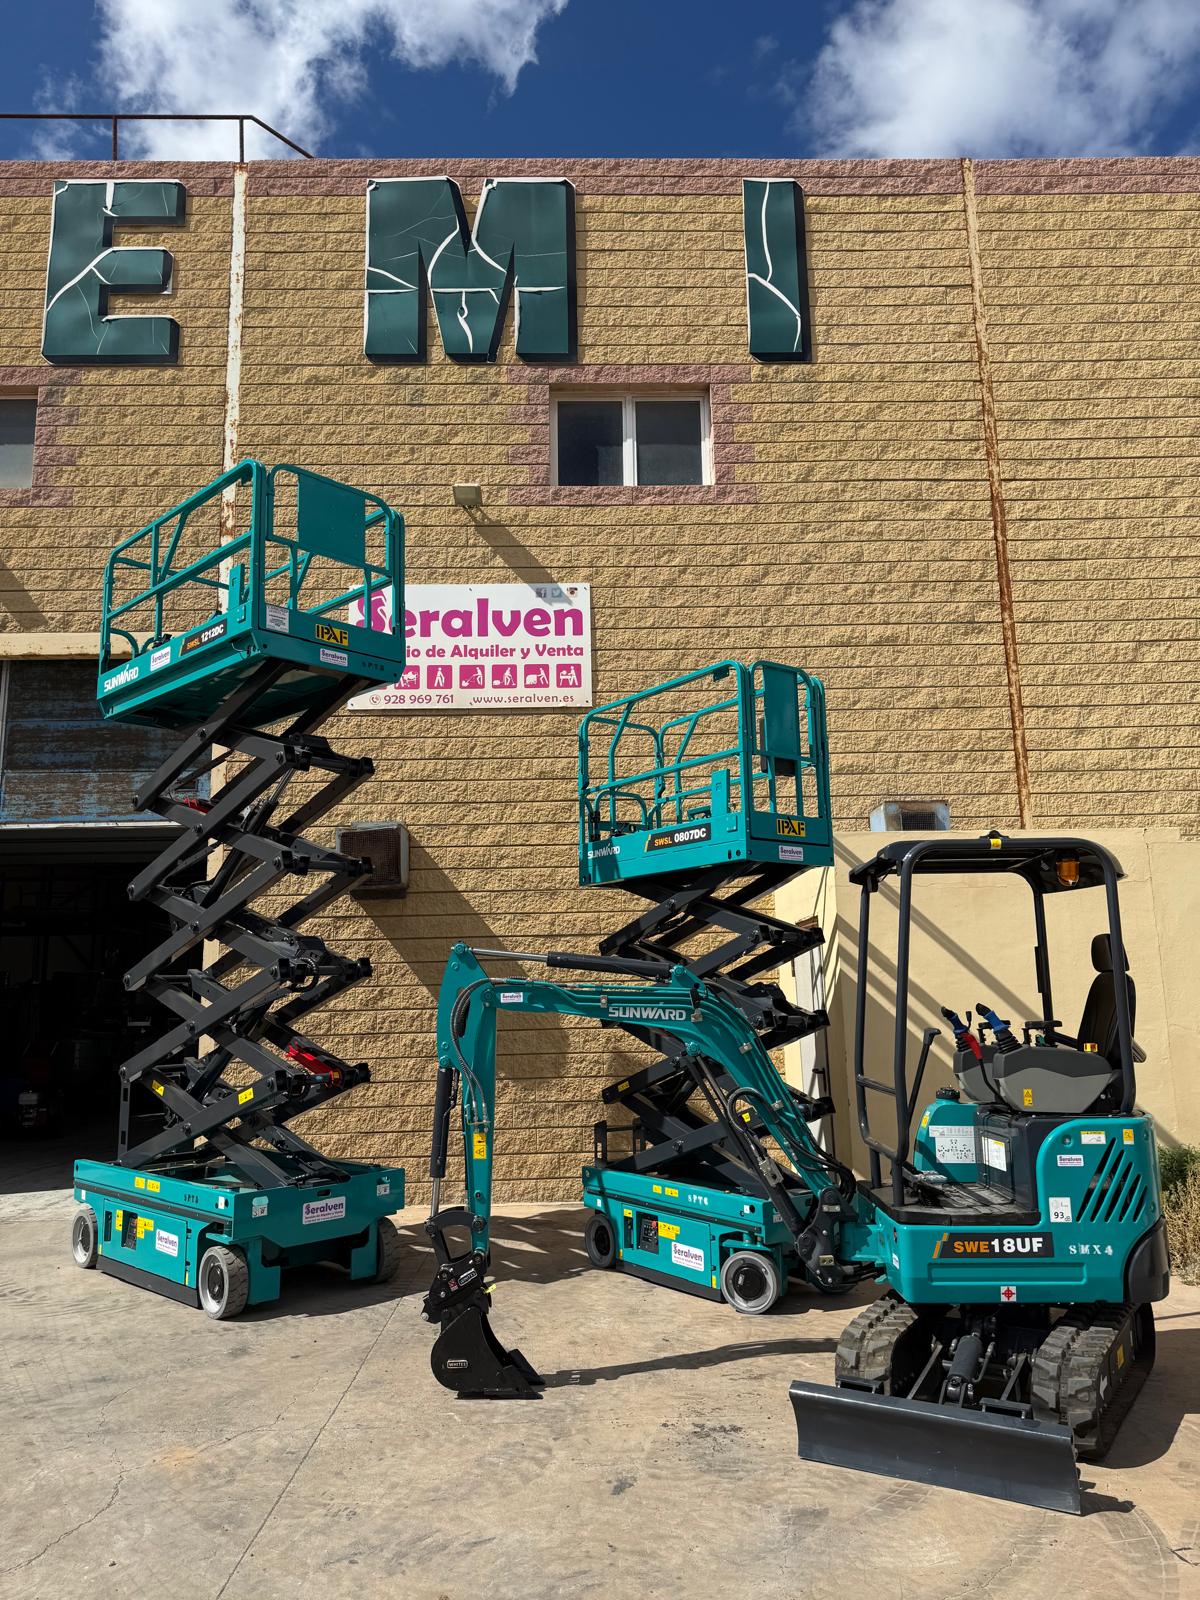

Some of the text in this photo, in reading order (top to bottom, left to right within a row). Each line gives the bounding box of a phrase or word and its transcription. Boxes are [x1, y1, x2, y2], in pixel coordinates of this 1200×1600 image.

[201, 624, 224, 642] 1212DC
[316, 623, 348, 645] IPAF
[321, 650, 347, 661] Seralven
[425, 645, 446, 657] de
[450, 643, 516, 659] Alquiler
[520, 647, 530, 659] y
[535, 644, 584, 656] Venta
[104, 664, 138, 692] SUNWARD
[384, 693, 575, 705] 928 969 761 www.seralven.es
[777, 816, 805, 837] IPAF
[654, 828, 707, 847] SWSL 0807DC
[587, 844, 621, 859] SUNWARD
[608, 1005, 686, 1021] SUNWARD
[304, 1203, 344, 1216] Seralven
[1053, 1211, 1065, 1219] 93
[672, 1243, 703, 1262] Seralven
